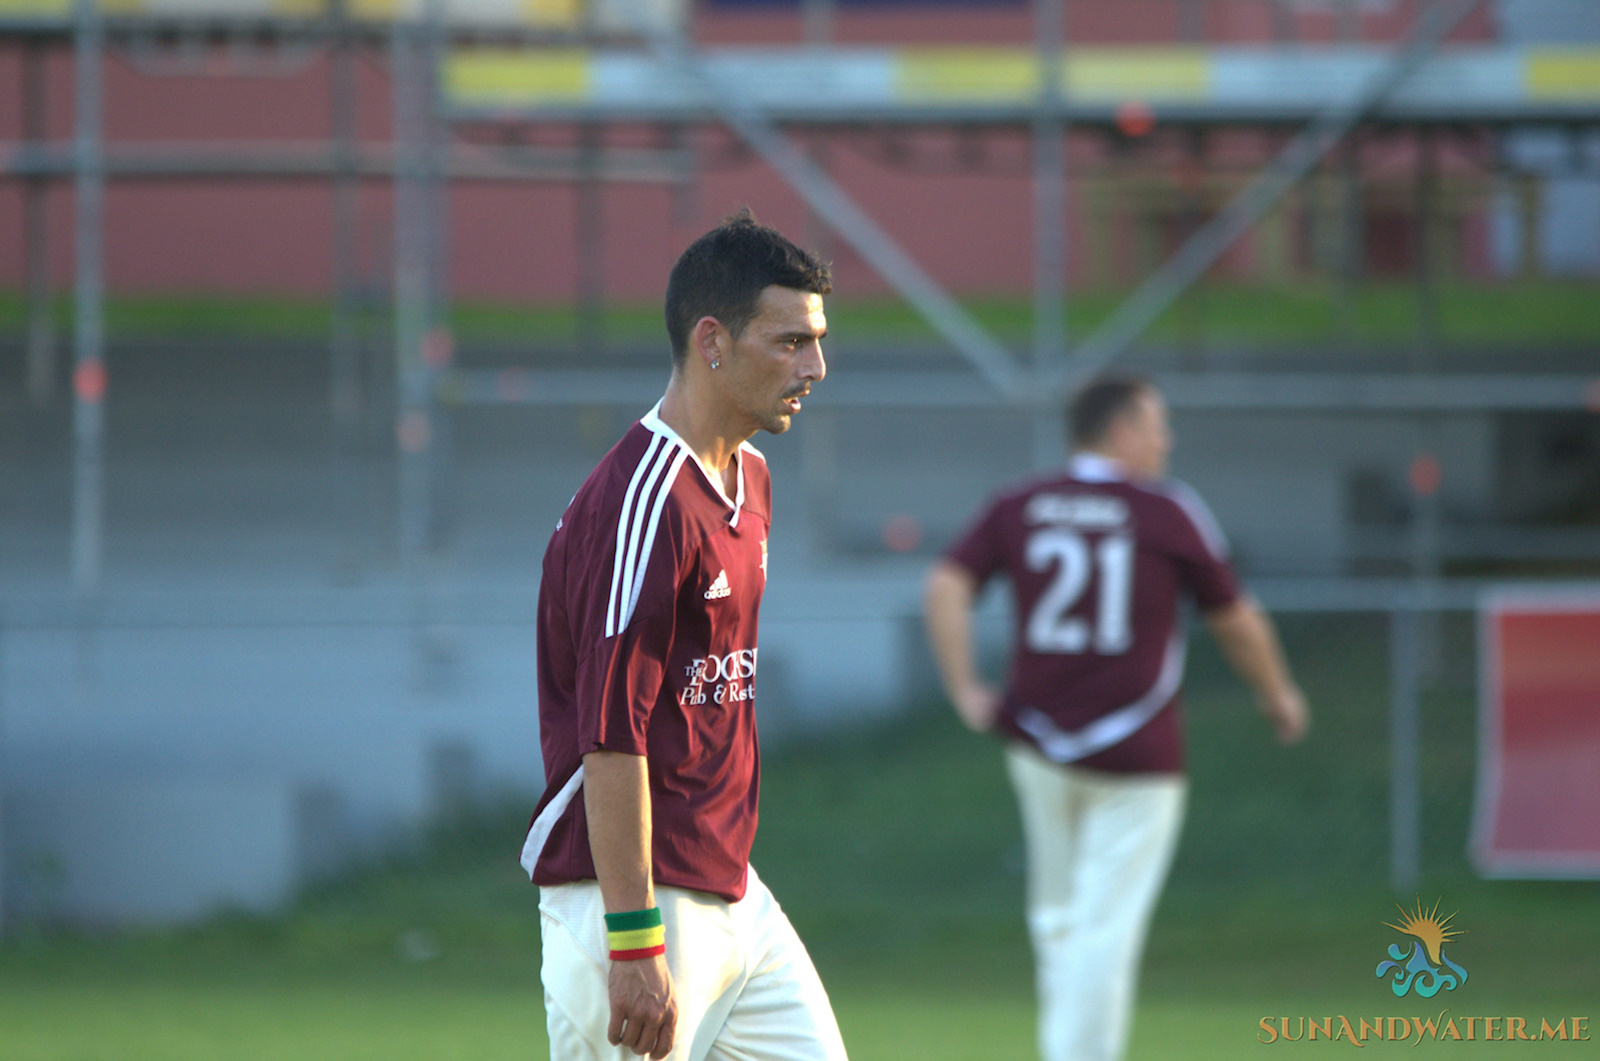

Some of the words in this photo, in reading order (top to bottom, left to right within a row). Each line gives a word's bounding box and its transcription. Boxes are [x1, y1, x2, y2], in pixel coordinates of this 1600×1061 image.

[1026, 528, 1134, 654] 21
[684, 666, 702, 677] THE
[680, 682, 707, 705] Pub
[713, 684, 727, 705] &
